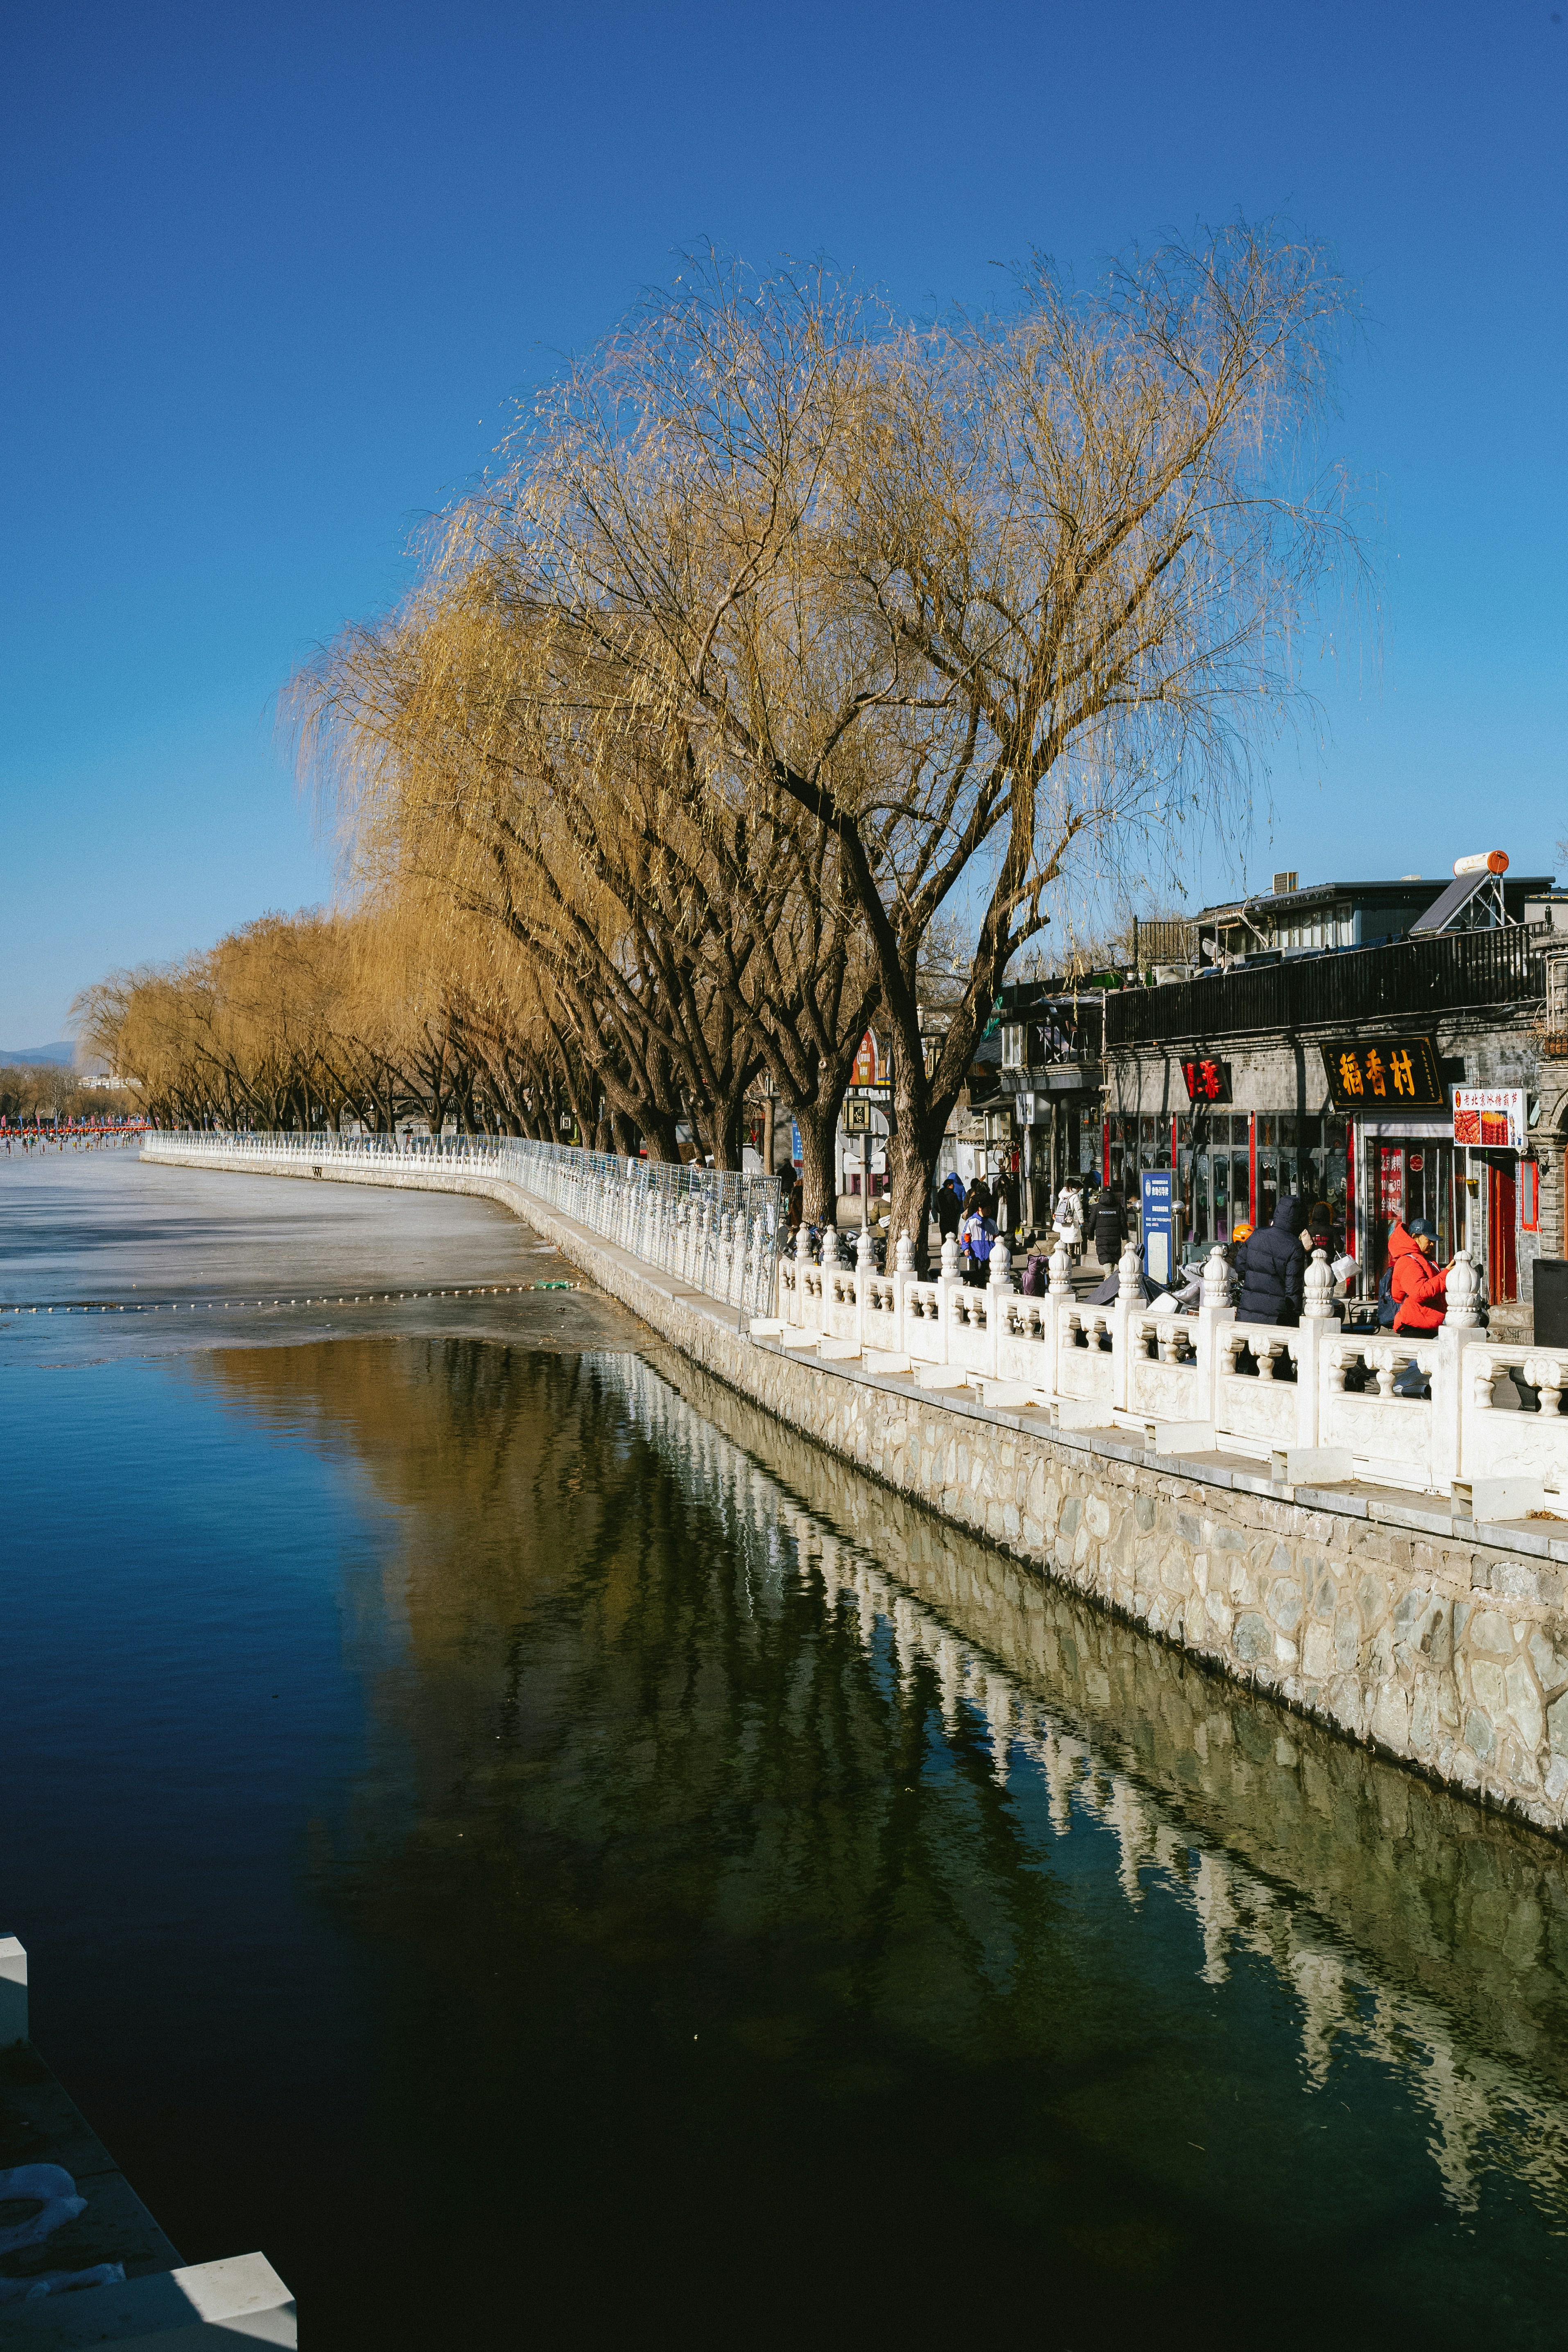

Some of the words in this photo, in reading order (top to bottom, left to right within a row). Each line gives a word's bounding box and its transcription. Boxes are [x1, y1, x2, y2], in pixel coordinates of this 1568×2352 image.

[1340, 1048, 1415, 1096] 稻香村
[1464, 1092, 1517, 1108] 老北京冰糖葫芦
[1381, 1155, 1401, 1171] 北京烤鸭
